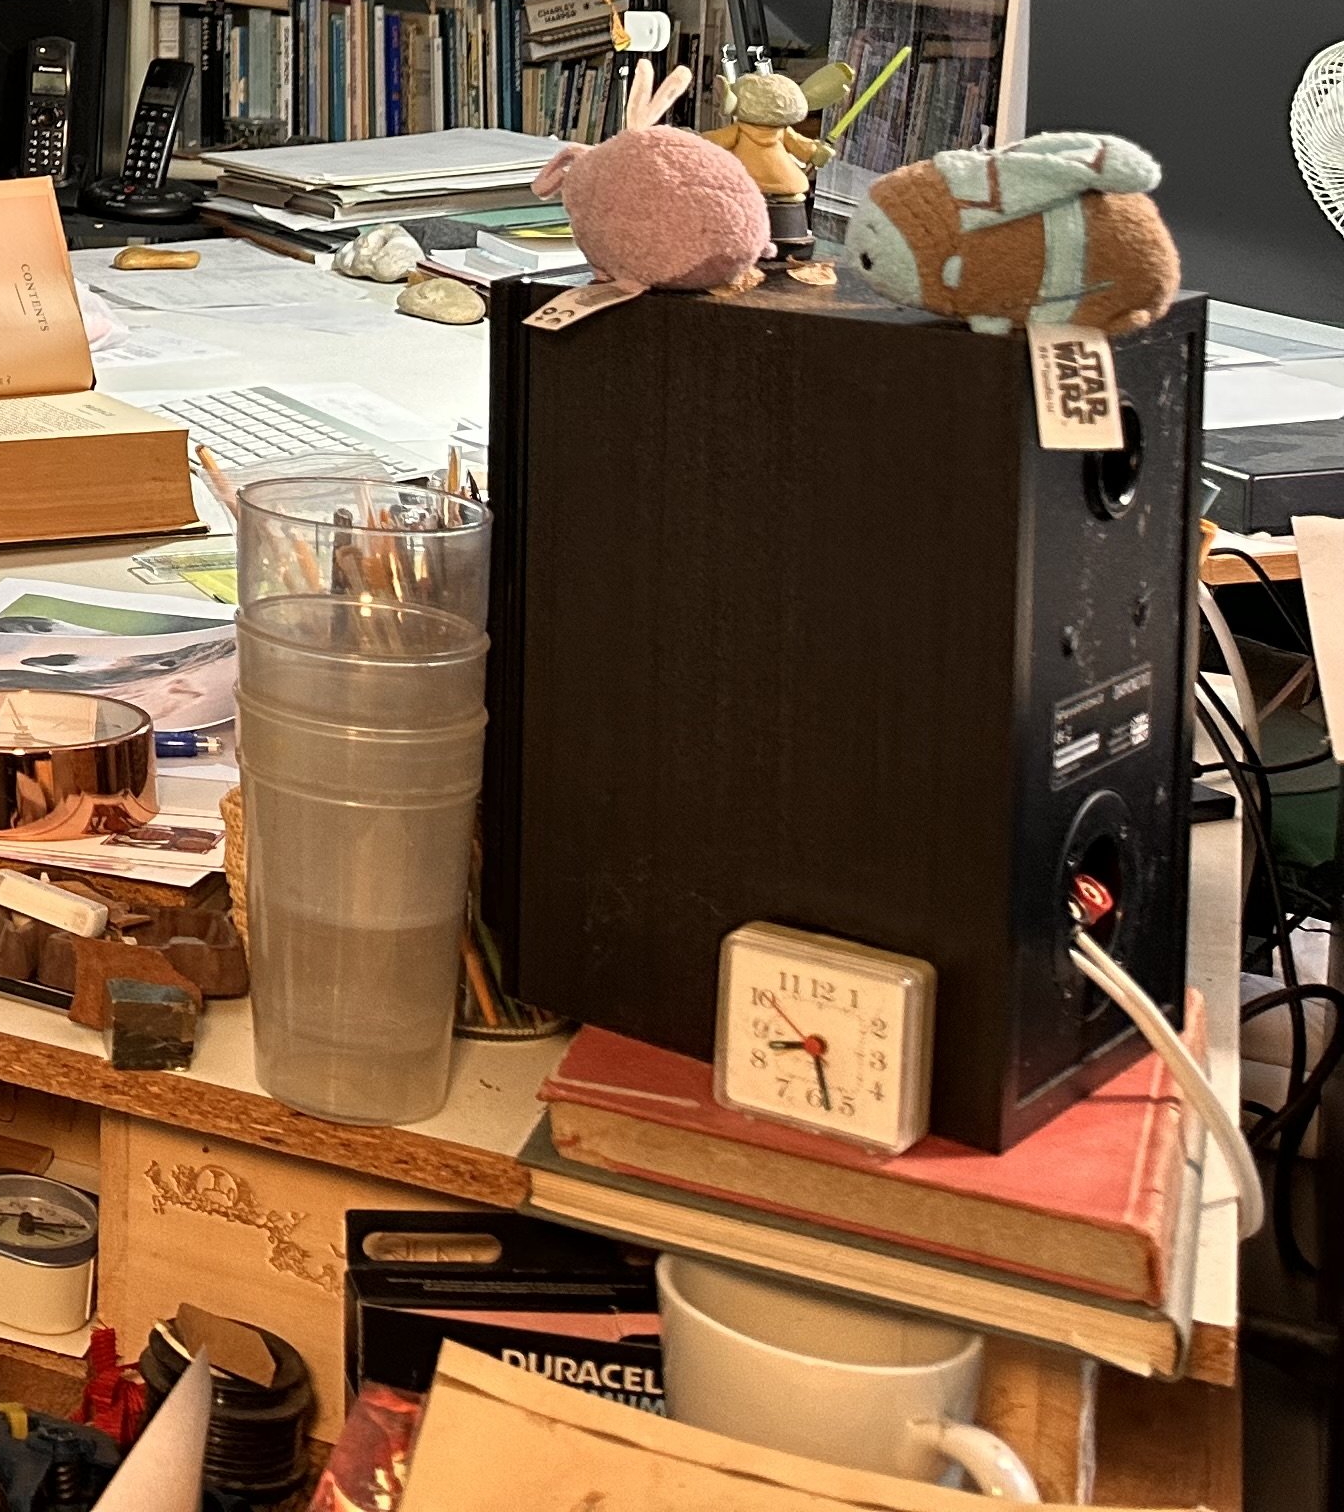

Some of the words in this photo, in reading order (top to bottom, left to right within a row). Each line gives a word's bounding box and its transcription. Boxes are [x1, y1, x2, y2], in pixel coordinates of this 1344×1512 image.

[20, 263, 50, 333] CONTENTS
[1052, 342, 1084, 424] WARS
[1073, 341, 1108, 424] STAR
[751, 987, 776, 1008] 10
[779, 971, 801, 994] 11
[811, 978, 836, 1002] 12
[849, 989, 858, 1008] 1
[752, 1017, 769, 1038] 9
[870, 1017, 888, 1039] 2
[749, 1048, 768, 1069] 8
[869, 1051, 888, 1071] 3
[776, 1076, 792, 1097] 7
[867, 1081, 885, 1101] 4
[838, 1094, 856, 1117] 5
[501, 1348, 664, 1395] DURACEL
